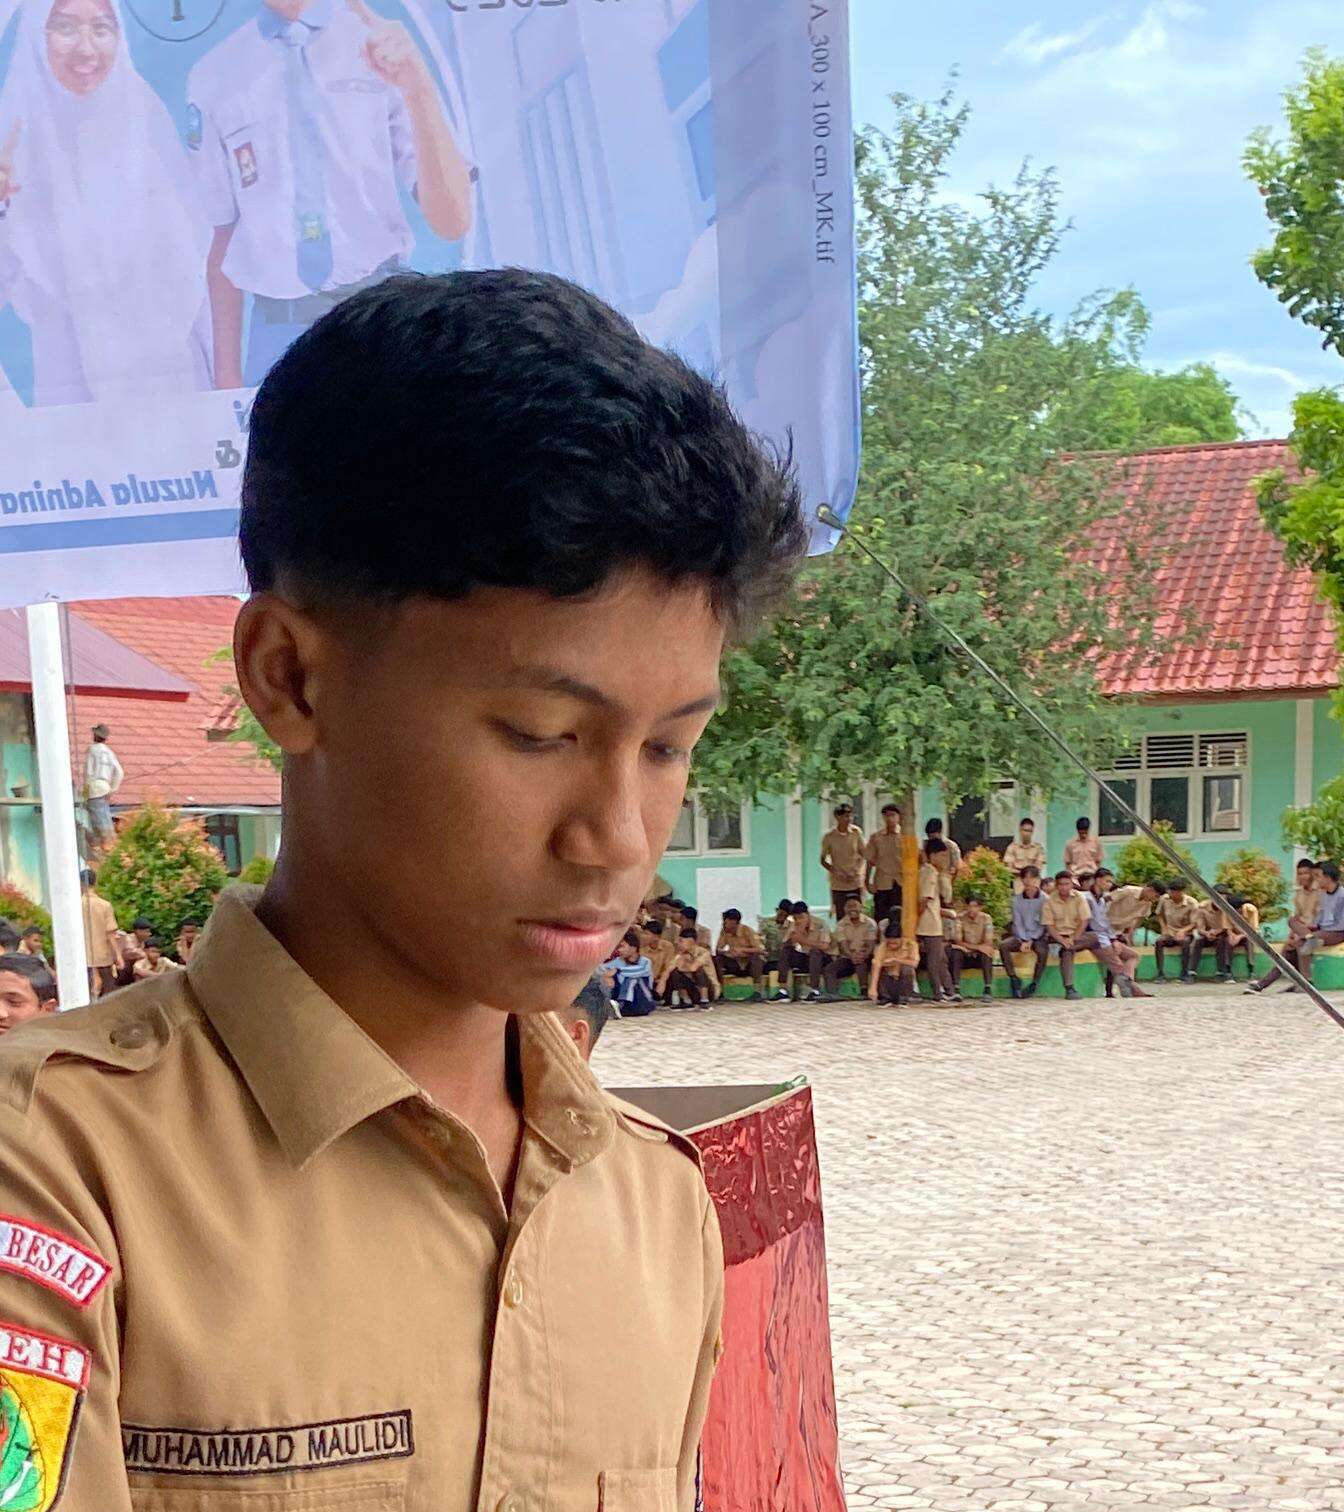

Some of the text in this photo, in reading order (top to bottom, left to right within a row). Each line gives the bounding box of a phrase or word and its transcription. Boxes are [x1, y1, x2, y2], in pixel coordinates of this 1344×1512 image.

[811, 79, 825, 93] x
[812, 100, 832, 138] 100
[6, 1227, 95, 1295] BESAR
[122, 1417, 406, 1467] MUHAMMAD MAULIDI
